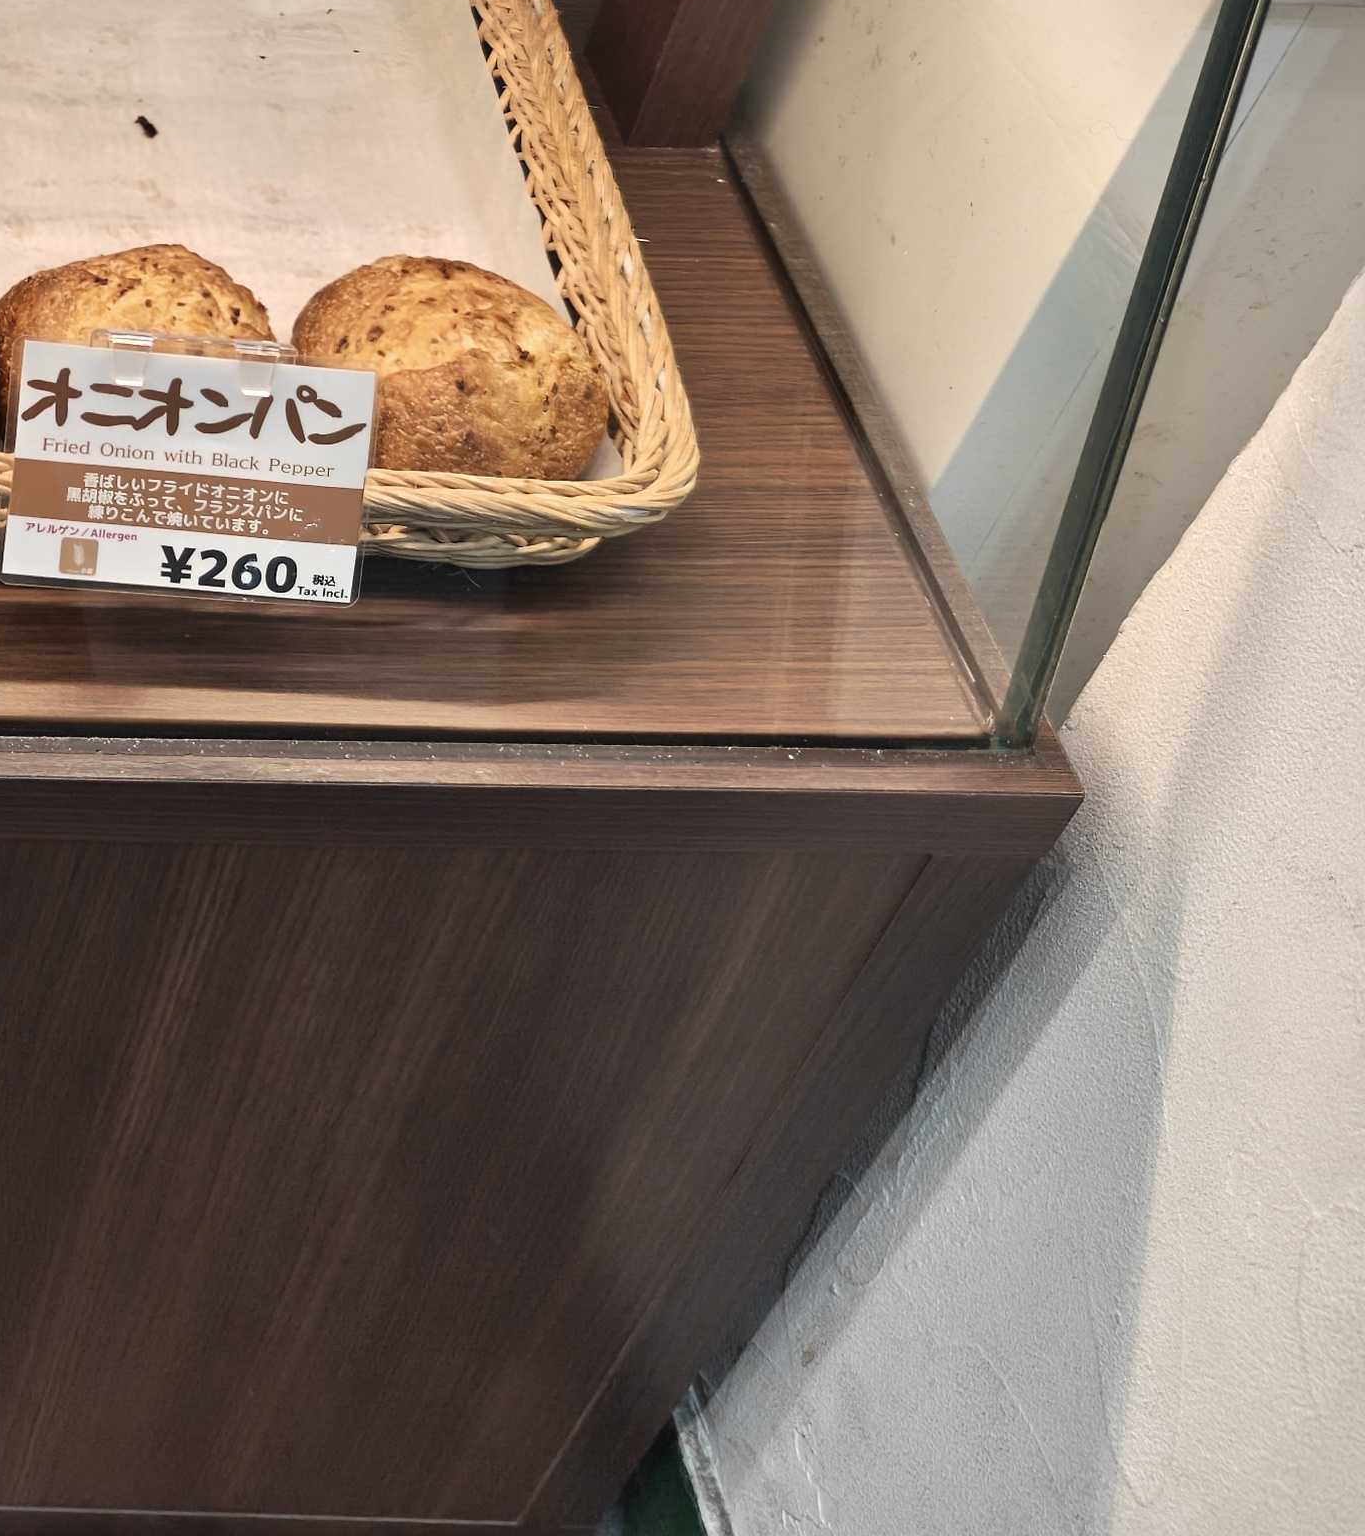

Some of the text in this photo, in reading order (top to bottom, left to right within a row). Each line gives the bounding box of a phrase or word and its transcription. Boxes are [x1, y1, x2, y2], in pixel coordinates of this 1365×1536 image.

[21, 367, 367, 445] オニオンパン
[43, 438, 334, 479] Fried Onion with Black Pepper
[66, 486, 304, 522] 黒胡椒をふって、フランスパンに
[83, 472, 289, 505] 香ばしいフライドオニオンに
[87, 505, 269, 536] 練りこんで焼いています。
[160, 544, 298, 594] ¥260
[312, 574, 336, 587] 税込
[297, 586, 349, 600] Tax Incl.
